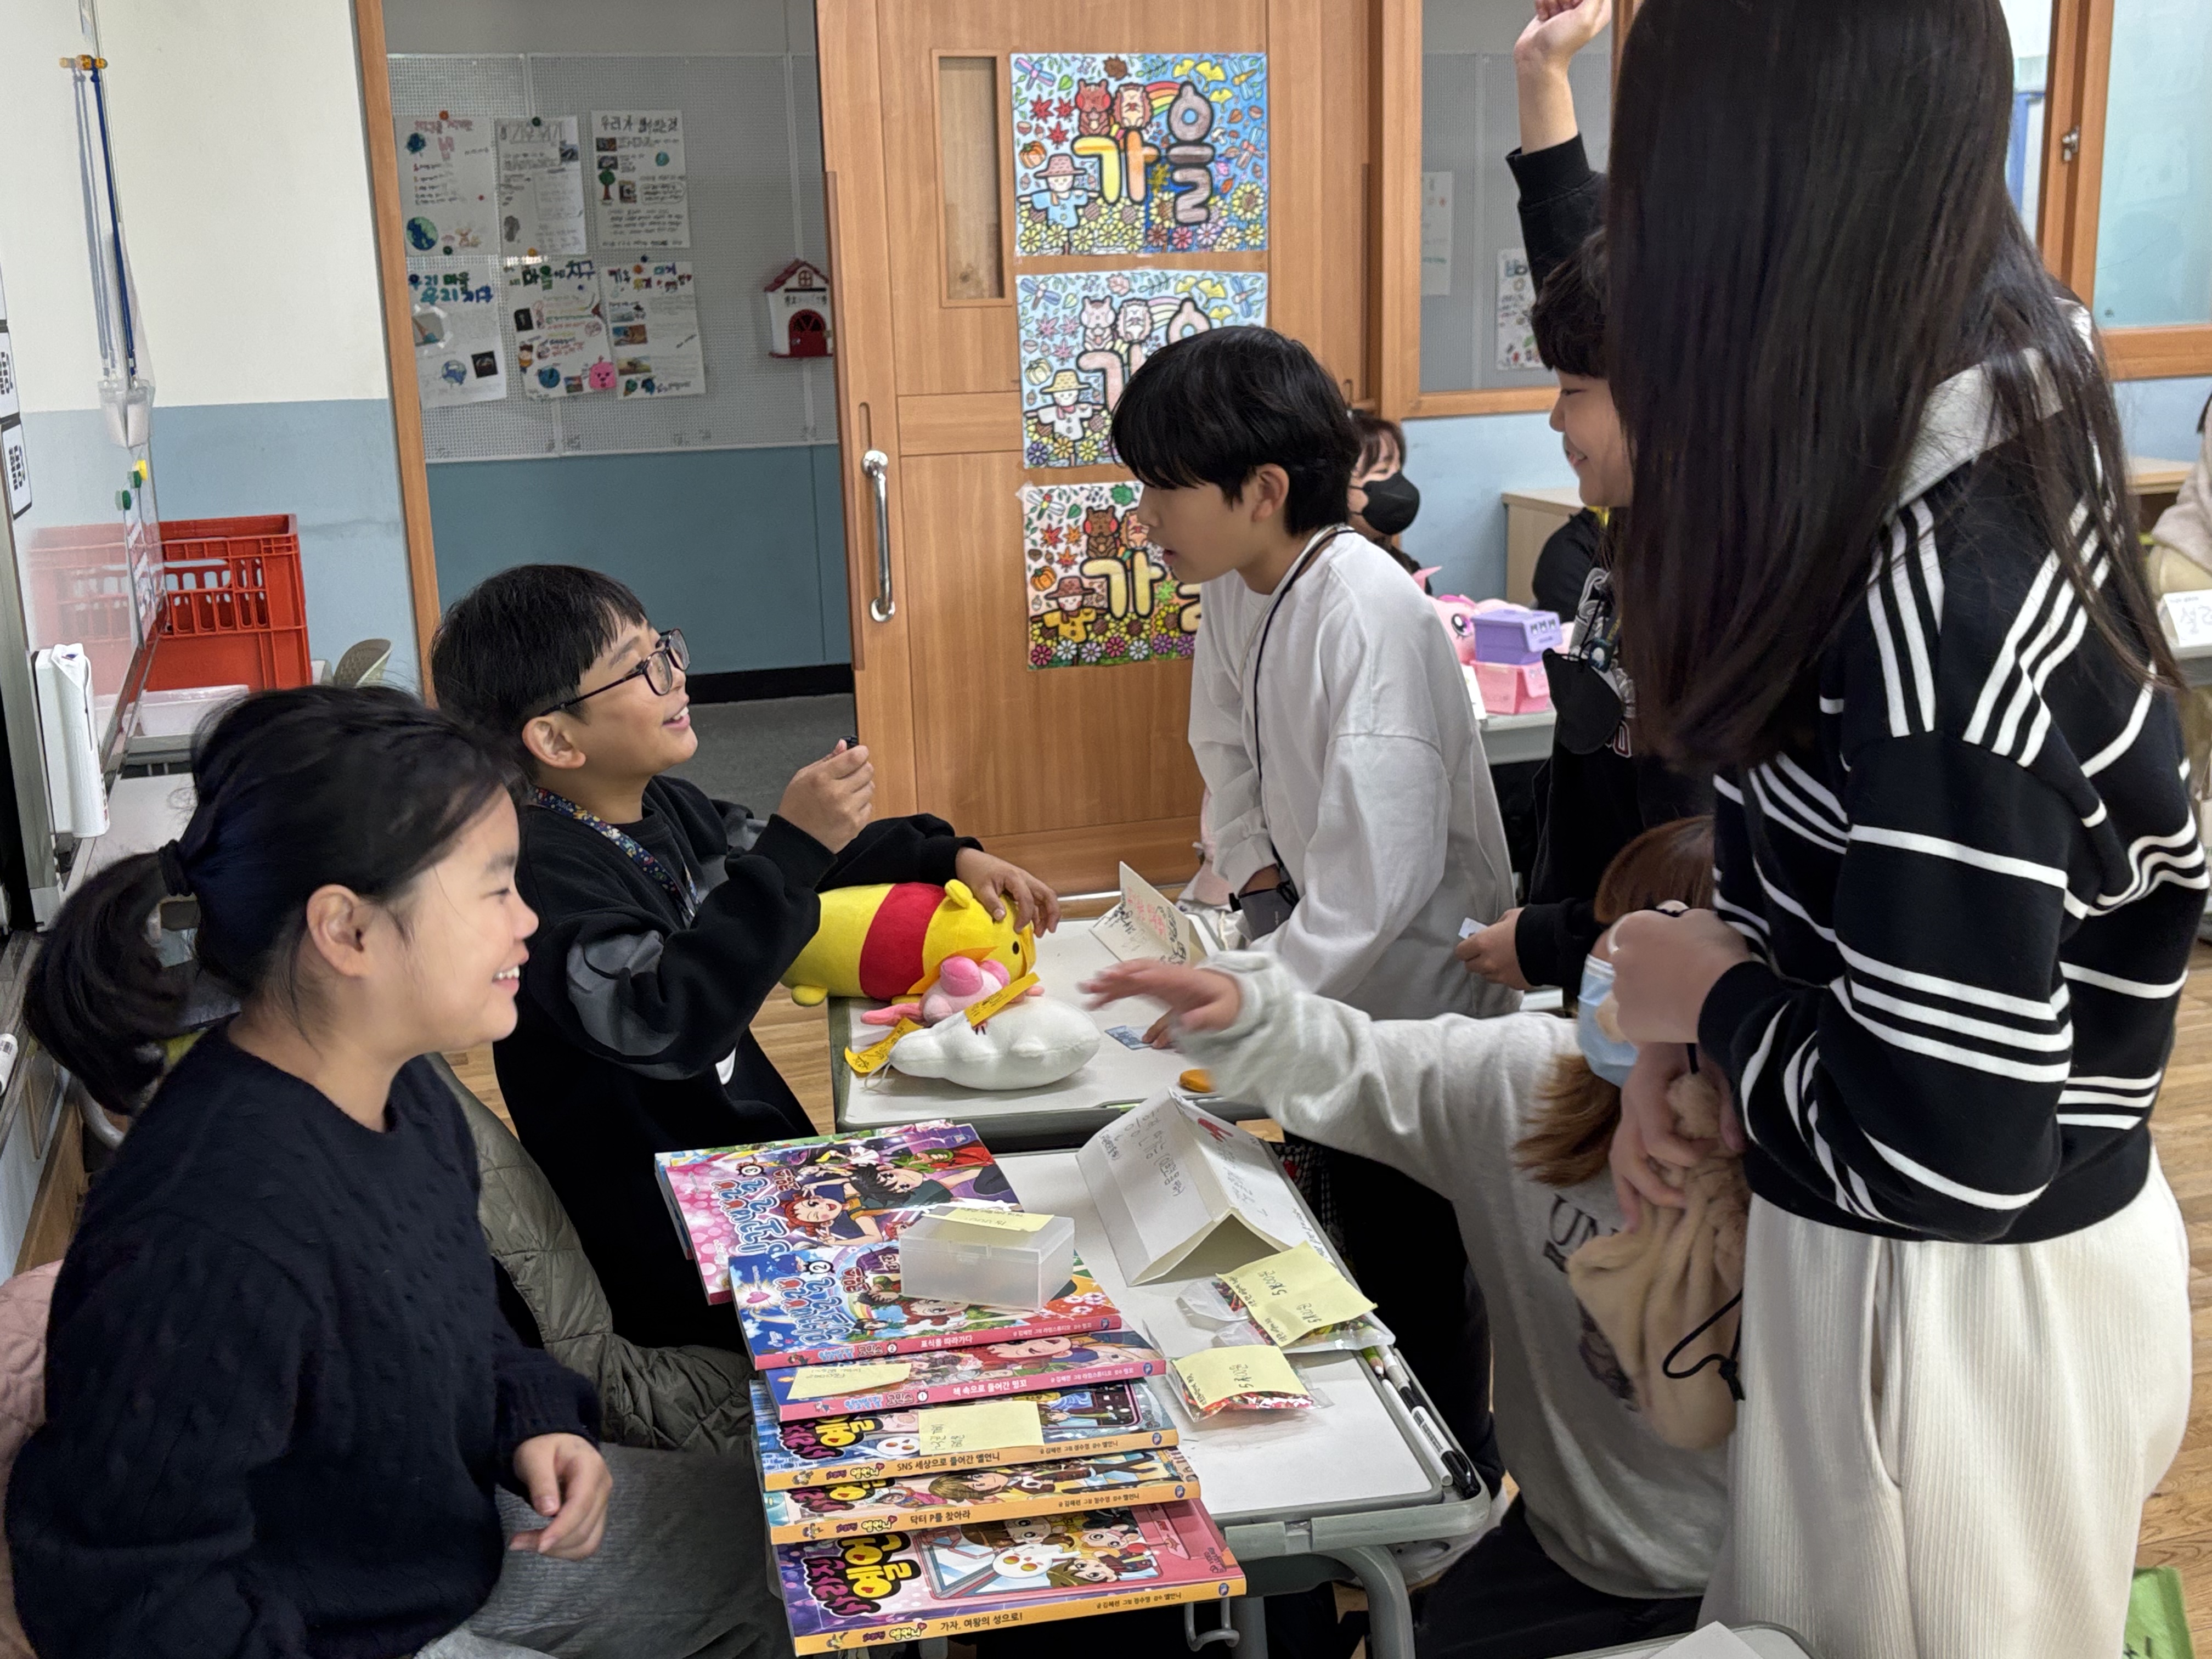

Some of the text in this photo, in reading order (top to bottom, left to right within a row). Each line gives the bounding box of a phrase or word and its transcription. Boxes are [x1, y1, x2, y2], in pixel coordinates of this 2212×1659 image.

[1072, 80, 1216, 225] 가을
[857, 1344, 884, 1357] 코믹스
[921, 1338, 943, 1348] 표식을
[944, 1335, 973, 1345] 따라가다
[886, 1392, 914, 1406] 코믹스
[953, 1387, 961, 1396] 책
[963, 1385, 986, 1395] 속으로
[988, 1381, 1010, 1392] 들어간
[1012, 1379, 1028, 1390] 밍꼬
[897, 1462, 913, 1471] SNS
[915, 1458, 947, 1470] 세상으로
[950, 1455, 974, 1466] 들어간
[976, 1452, 1000, 1463] 옐언니
[910, 1515, 927, 1524] 닥터
[930, 1513, 943, 1522] P를
[946, 1510, 970, 1521] 찾아라
[842, 1534, 912, 1598] 옐언
[809, 1559, 871, 1613] 사라진
[964, 1617, 990, 1628] 여왕의
[993, 1612, 1023, 1624] 성으로!
